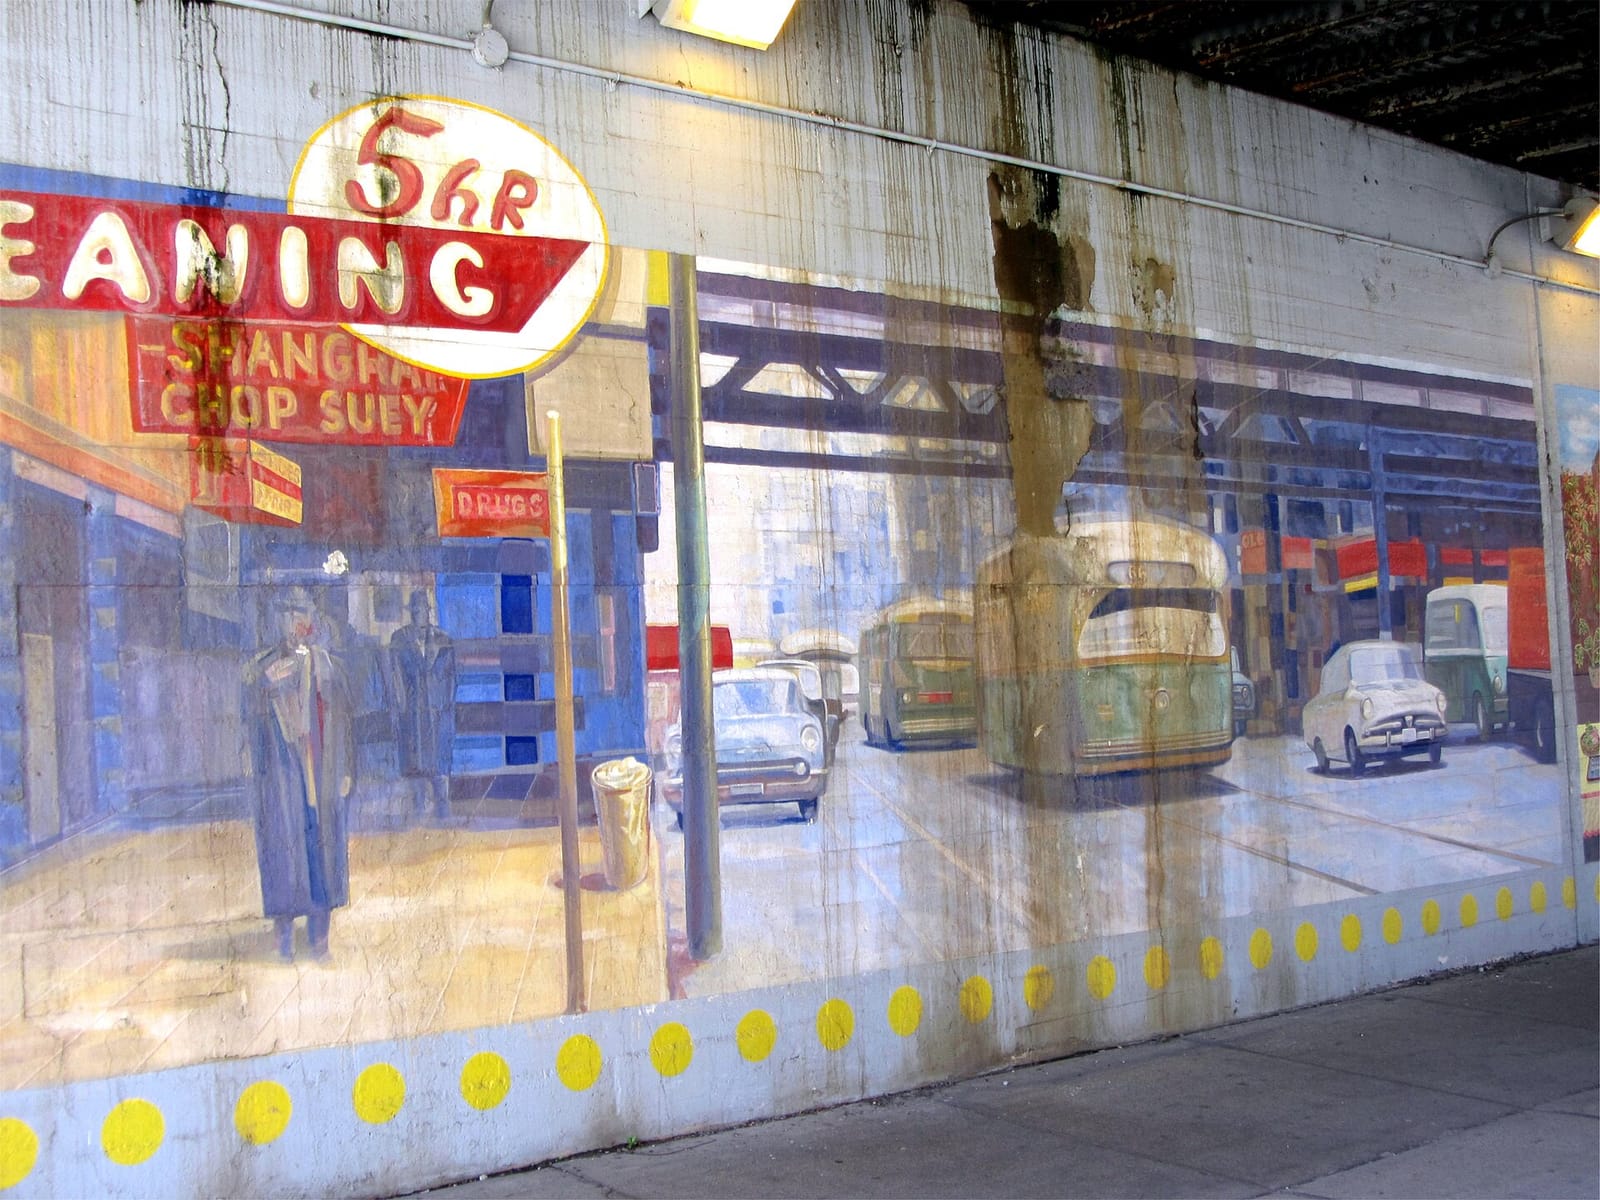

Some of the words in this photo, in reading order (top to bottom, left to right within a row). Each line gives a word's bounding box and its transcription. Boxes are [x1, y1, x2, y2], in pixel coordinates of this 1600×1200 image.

[161, 383, 297, 430] CHOP
[319, 389, 435, 435] SUEY
[457, 491, 543, 517] DRUGS
